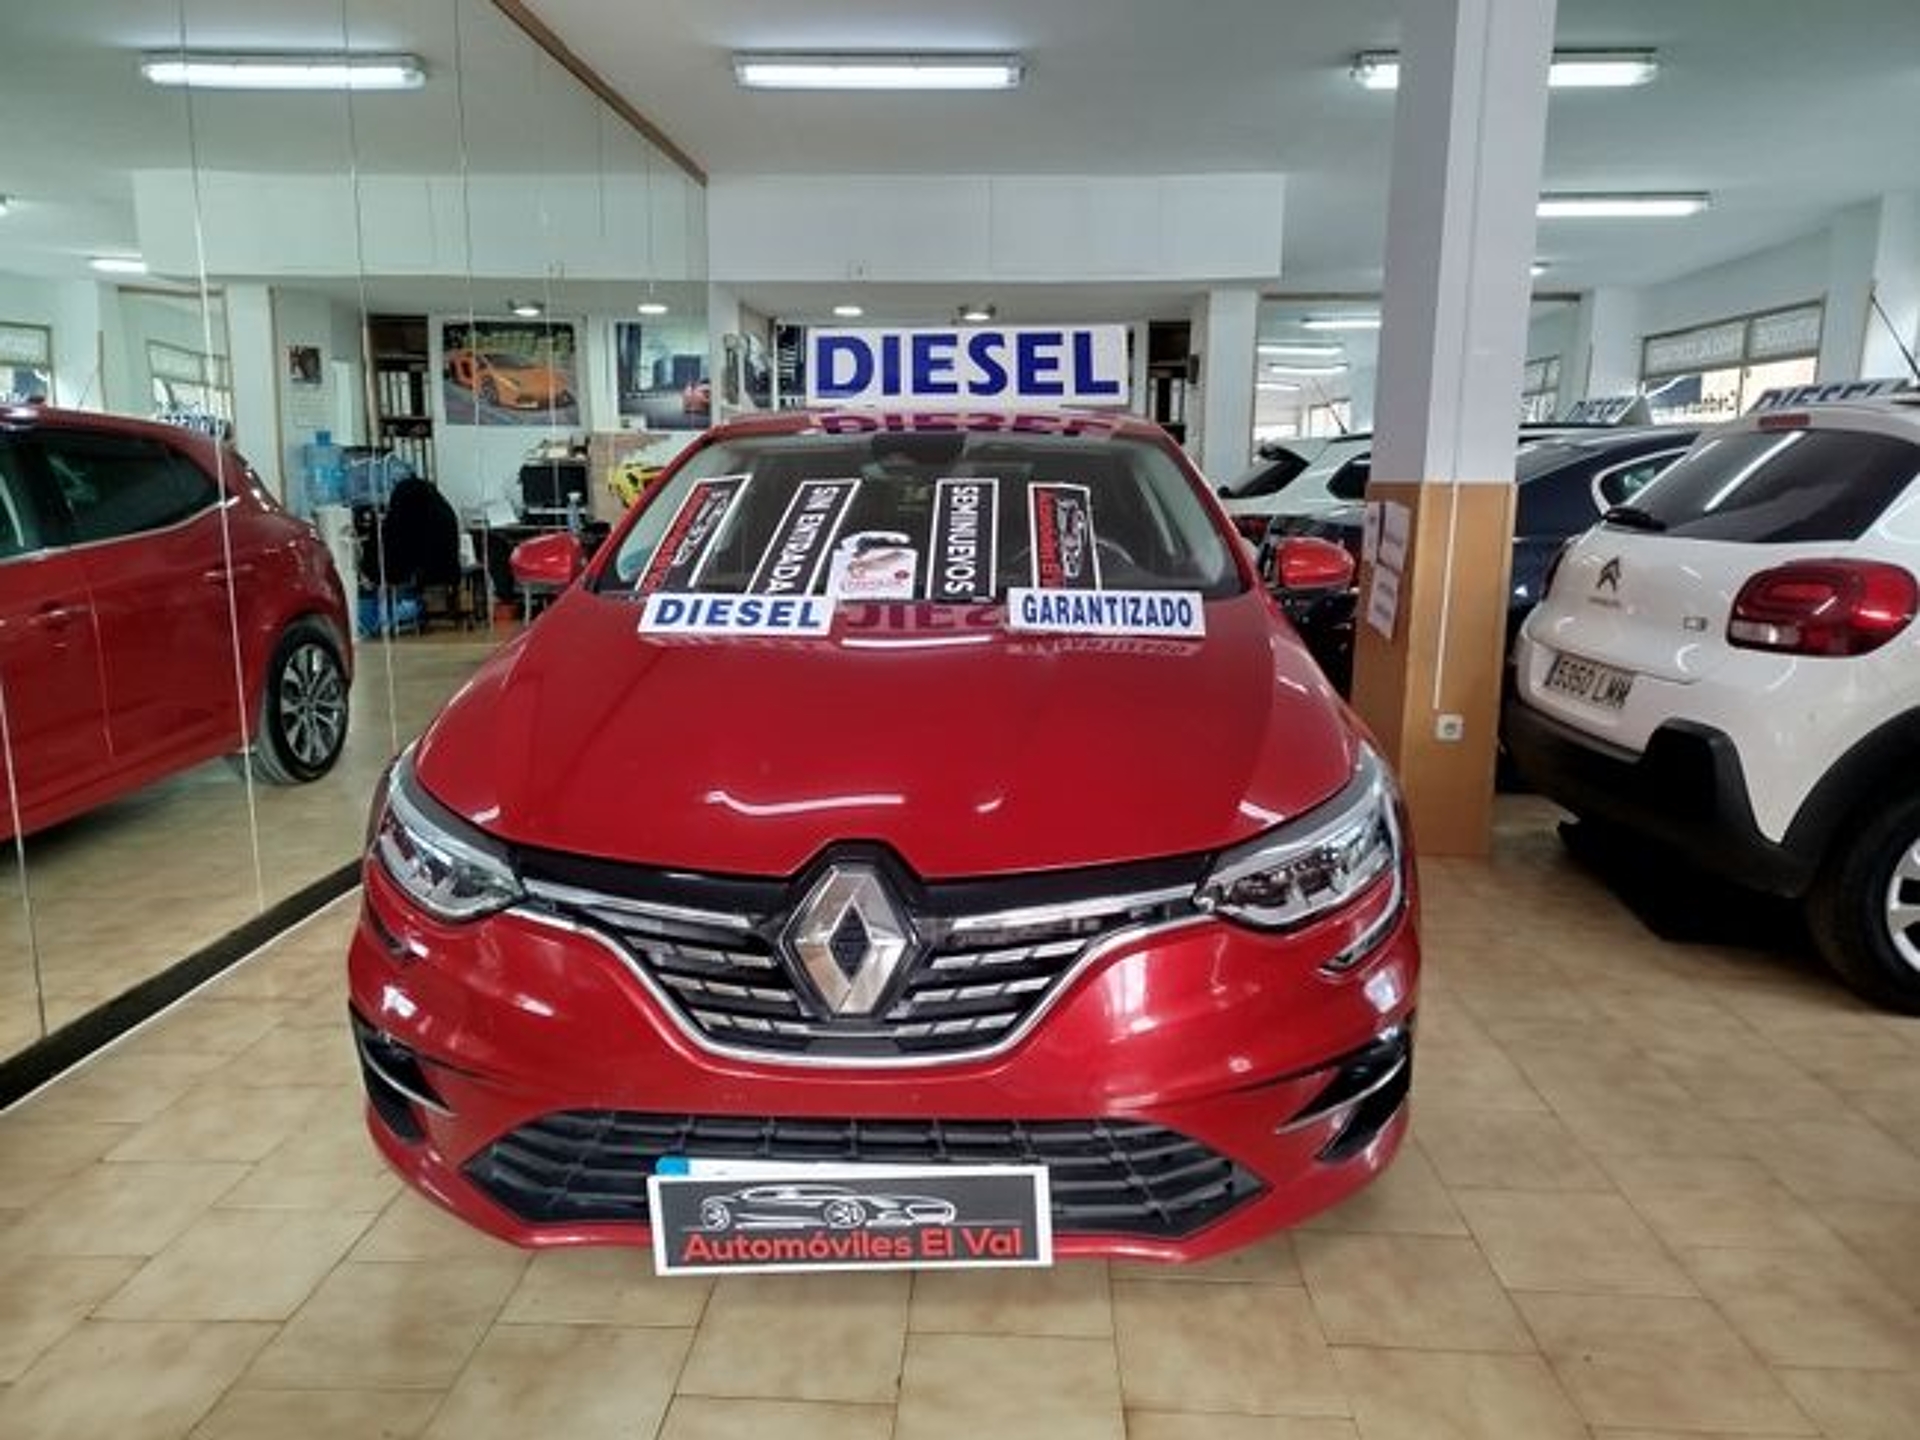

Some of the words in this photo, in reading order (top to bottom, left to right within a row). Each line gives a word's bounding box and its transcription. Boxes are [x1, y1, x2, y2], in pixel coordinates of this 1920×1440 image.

[815, 331, 1120, 398] DIESEL
[804, 486, 840, 510] SIN
[766, 511, 827, 595] ENTRADA
[944, 486, 980, 593] SEMINUEVOS
[654, 598, 821, 628] DIESEL
[1021, 594, 1193, 628] GARANTIZADO
[683, 1230, 912, 1262] Automóviles
[920, 1228, 955, 1256] El
[961, 1227, 1022, 1256] Val
